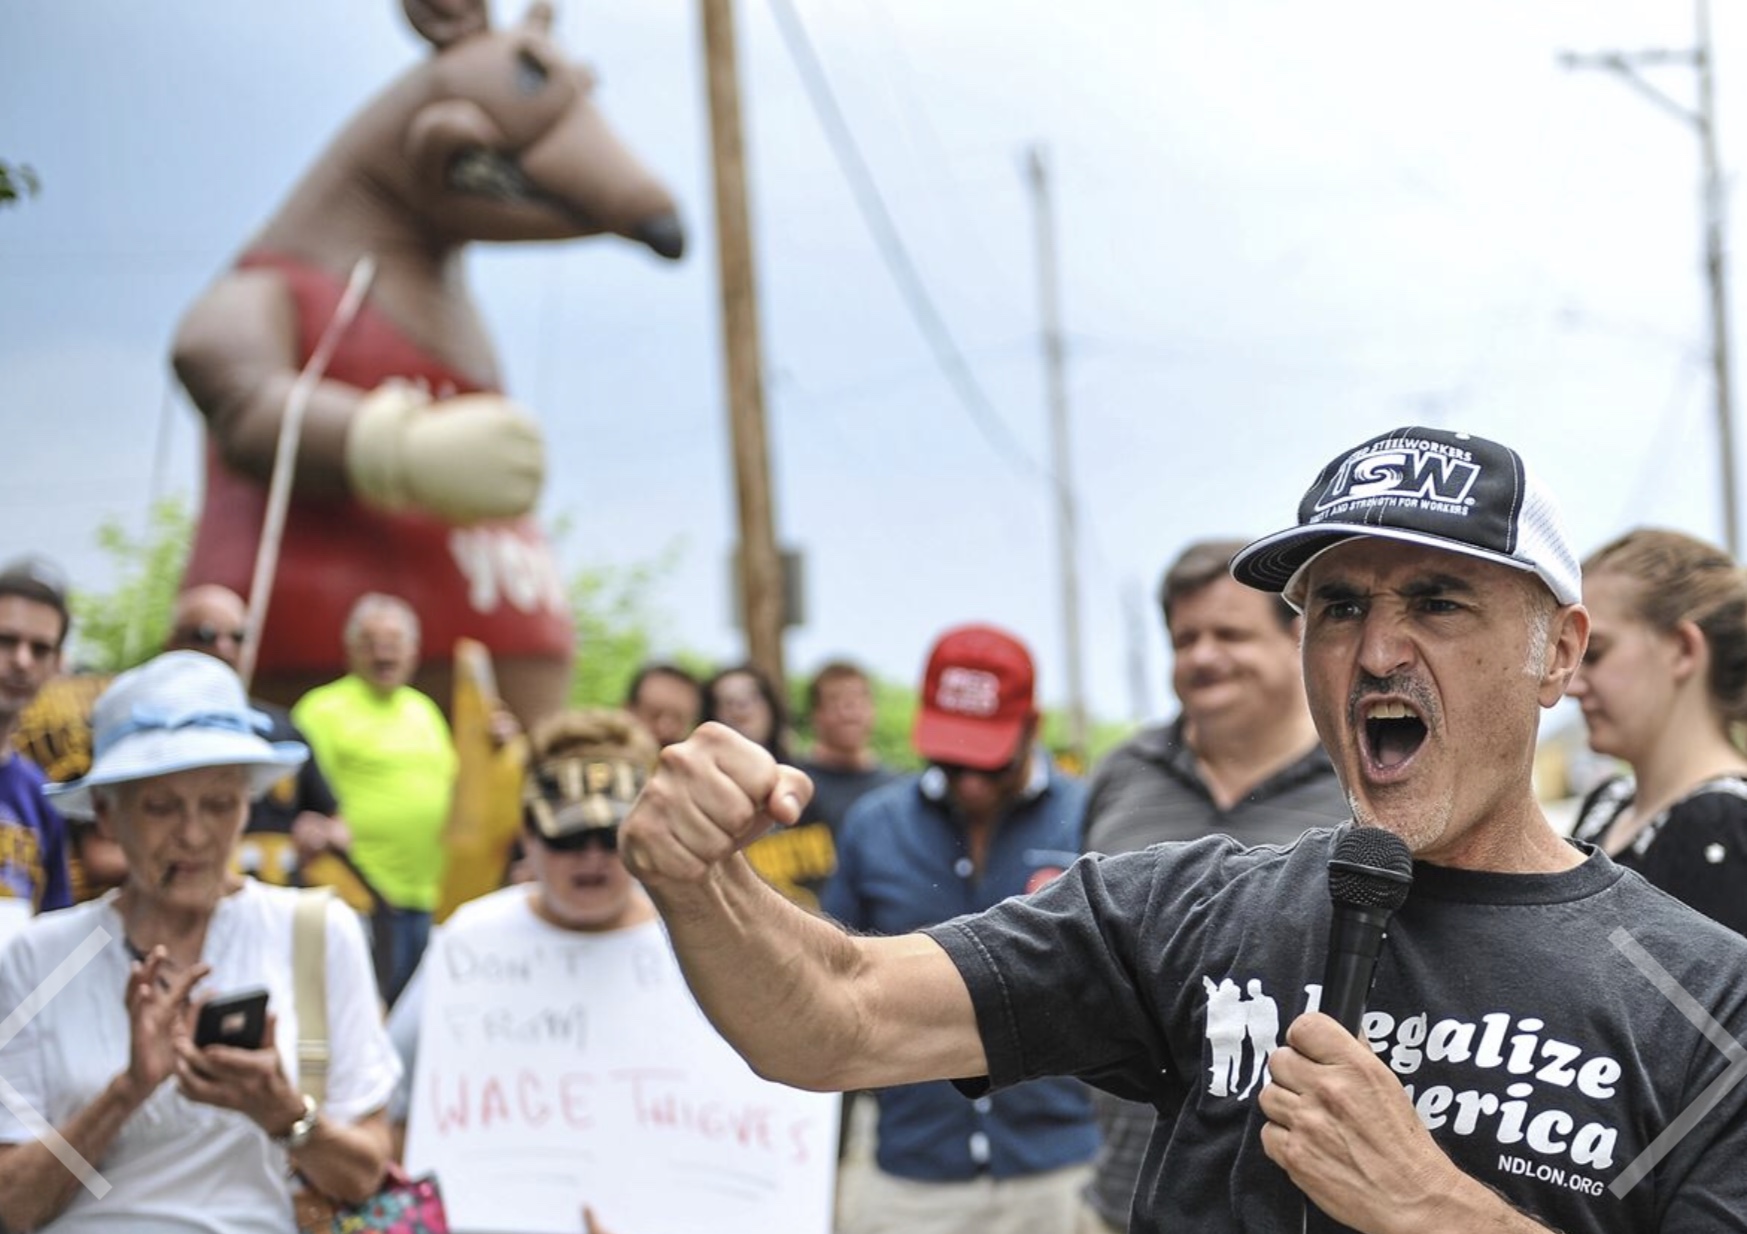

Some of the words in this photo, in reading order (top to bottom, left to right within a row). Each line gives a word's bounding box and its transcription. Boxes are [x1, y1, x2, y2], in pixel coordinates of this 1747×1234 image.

[1372, 438, 1472, 461] STEELWORKERS
[1330, 503, 1349, 516] AND
[1349, 497, 1397, 511] STRENGTH
[1398, 497, 1419, 508] FOR
[1420, 500, 1469, 516] WORKERS
[429, 1067, 597, 1136] WAGE
[1406, 1081, 1619, 1171] erica
[1497, 1154, 1605, 1197] NDLON.ORG
